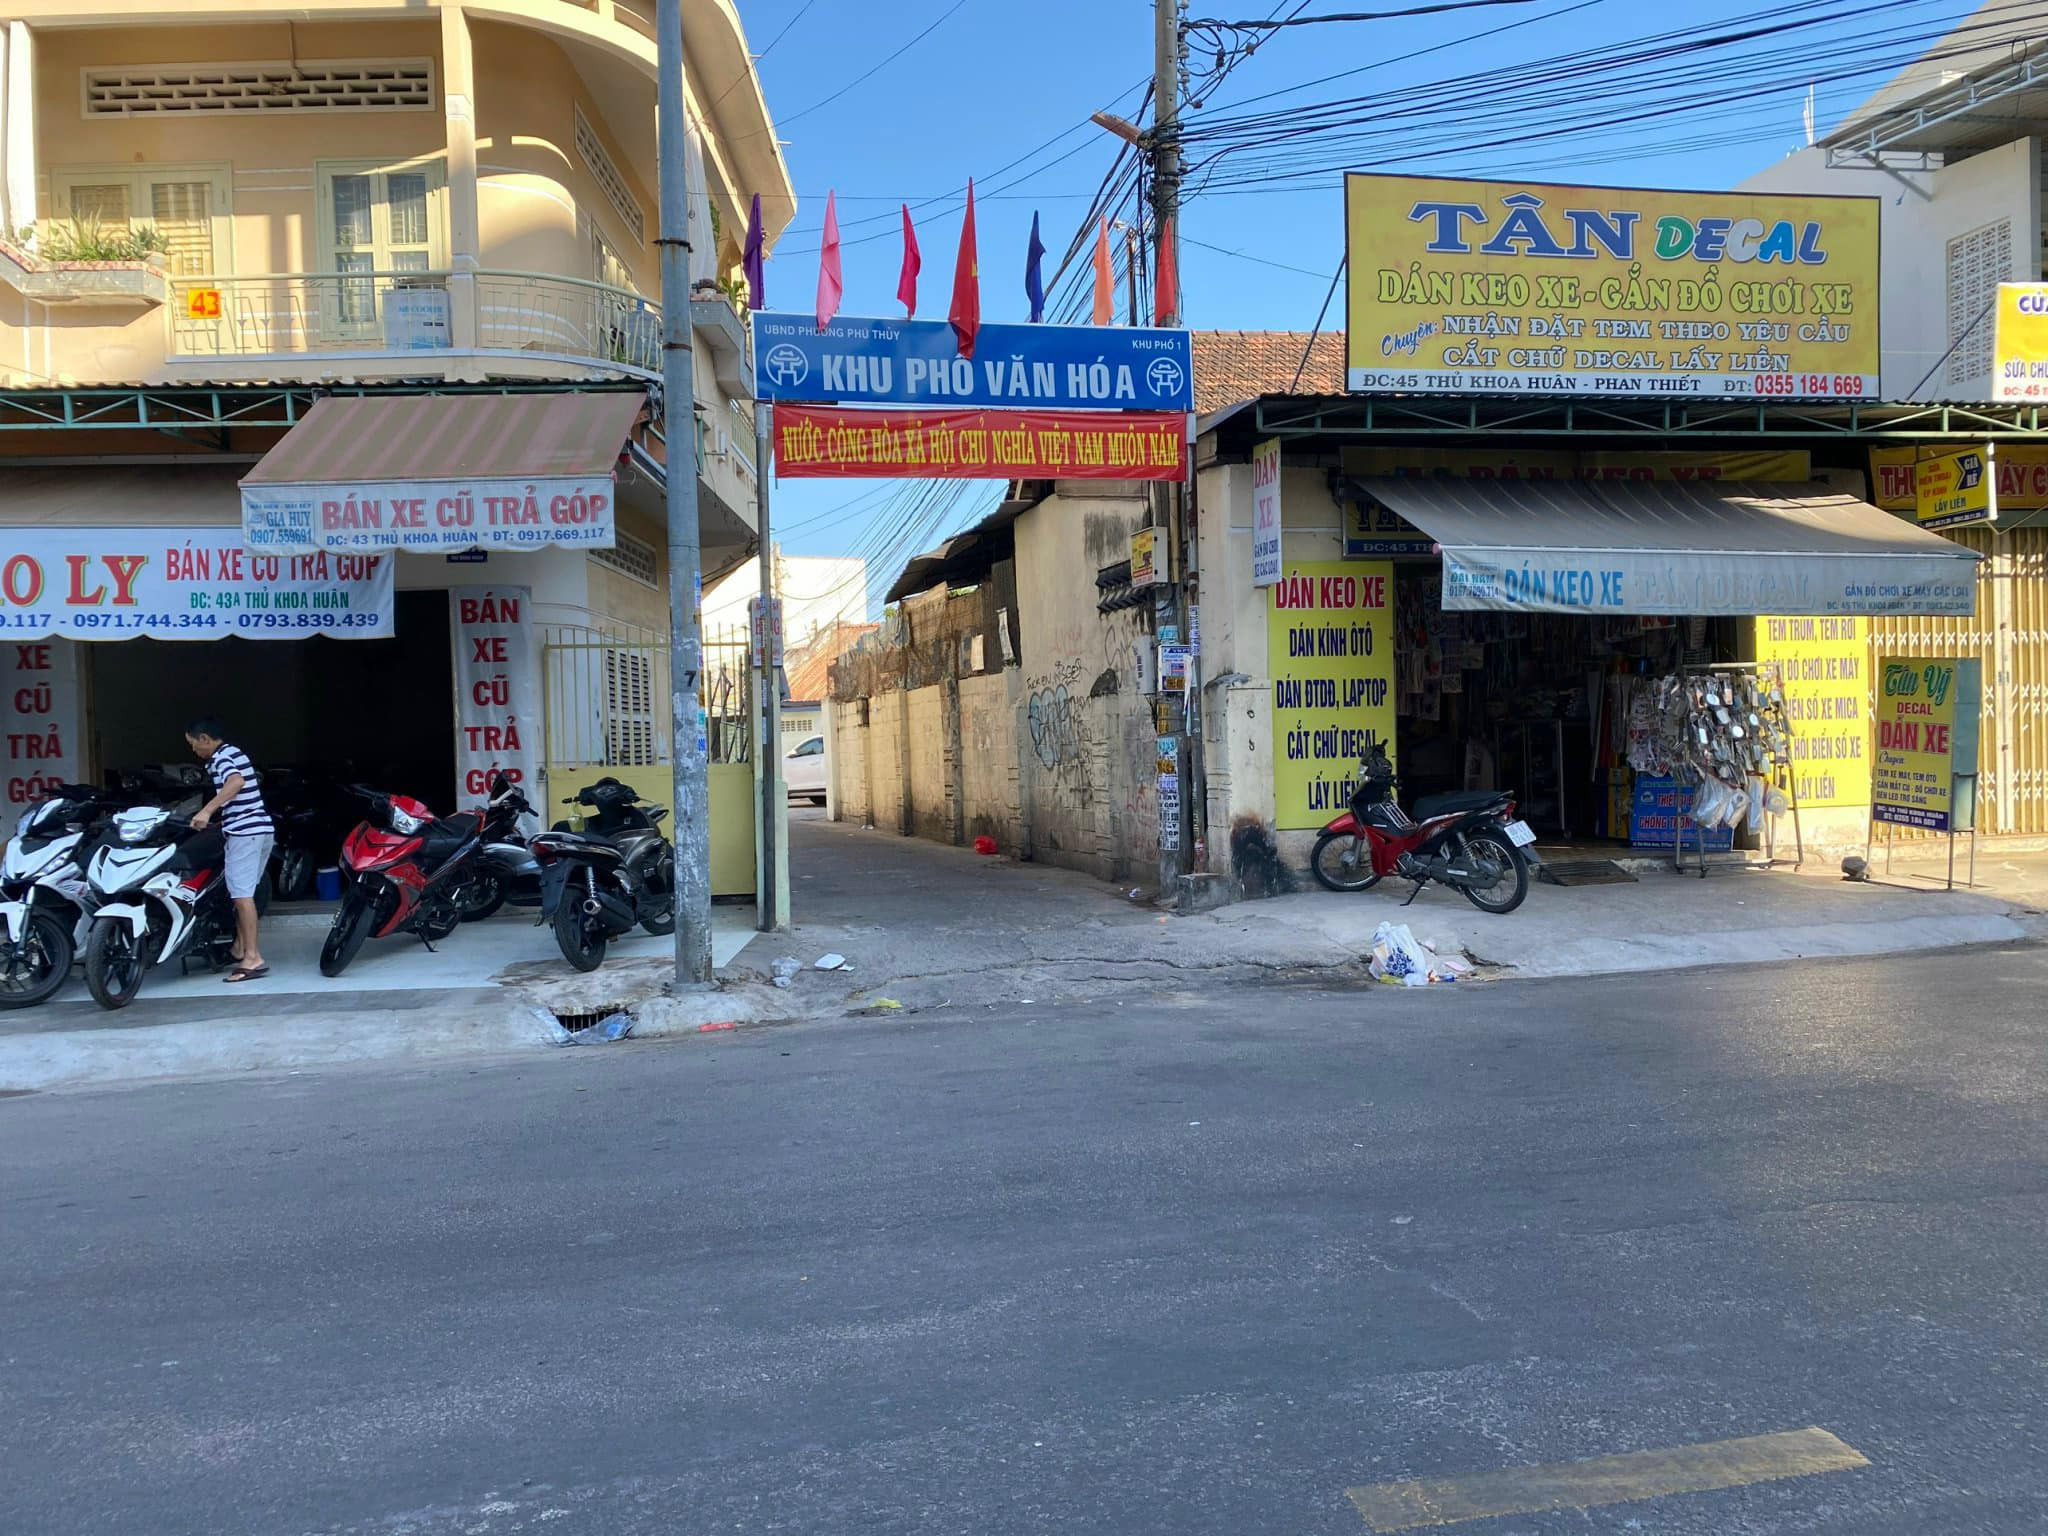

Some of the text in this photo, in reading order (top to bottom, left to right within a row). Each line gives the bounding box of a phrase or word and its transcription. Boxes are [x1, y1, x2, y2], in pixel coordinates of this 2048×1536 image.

[1407, 191, 1827, 264] TÂN DECAL
[191, 292, 220, 316] 43
[1377, 261, 1454, 305] DÁN
[1461, 273, 1530, 307] KEO
[1677, 264, 1722, 313] ĐỒ
[1730, 277, 1805, 314] CHƠI
[1810, 283, 1853, 315] XE
[764, 324, 795, 336] UBND
[873, 326, 900, 341] THỦY
[1442, 311, 1850, 342] NHẬN ĐẶT TEM THEO YÊU CẦU
[1132, 340, 1151, 350] KHU
[1155, 338, 1173, 350] PHỐ
[1442, 339, 1790, 372] CẮT CHỮ DECAL LẤY LIỀN
[822, 354, 892, 394] KHU
[983, 354, 1056, 398] VĂN
[1067, 356, 1136, 399] HÓA
[1425, 371, 1462, 389] THỦ
[1470, 377, 1522, 389] KHOA
[1527, 374, 1577, 390] HUÂN
[1595, 377, 1641, 391] PHAN
[1647, 374, 1701, 392] THIẾT
[1754, 374, 1794, 395] 0355
[1800, 375, 1828, 394] 184
[1833, 375, 1862, 395] 669
[2025, 385, 2040, 396] 45
[782, 416, 1179, 472] NƯỚC CỘNG HÒA XÃ HỘI CHỦ NGHĨA VIỆT NAM MUÔN NĂM
[1254, 446, 1277, 489] DÁN
[266, 511, 311, 527] GIA HUY
[322, 485, 608, 530] BÁN XE CŨ TRẢ GÓP
[1258, 496, 1273, 531] XE
[352, 535, 369, 545] 43
[372, 532, 399, 545] THỦ
[403, 533, 438, 544] KHOA
[443, 530, 478, 543] HUÂN
[518, 528, 605, 540] 0917.669.117
[166, 540, 243, 581] BÁN XE
[64, 555, 149, 607] LY
[191, 585, 349, 609] ĐC: 43A THỦ KHOA HUÂN
[1275, 571, 1384, 609] DÁN KEO XE
[1505, 559, 1624, 606] DÁN KEO XE
[74, 613, 217, 628] 0971.744.344
[239, 613, 379, 628] 0793.839.439
[460, 592, 520, 624] BÁN
[1289, 620, 1373, 657] DÁN KÍNH ÔTÔ
[1768, 619, 1786, 641] TEM
[1820, 618, 1838, 641] TEM
[16, 645, 51, 670] XE
[472, 637, 509, 663] XE
[1787, 650, 1860, 681] ĐỒ CHƠI XE MÁY
[472, 675, 510, 706] CŨ
[684, 670, 697, 687] 7
[1276, 673, 1301, 709] DÁN
[1343, 678, 1387, 707] LAPTOP
[14, 682, 52, 714] CŨ
[1807, 688, 1858, 720] SỐ XE MICA
[1897, 702, 1933, 716] DECAL
[7, 723, 63, 759] TRẢ
[464, 715, 521, 752] TRẢ
[1287, 719, 1310, 760] CẮT
[1314, 724, 1339, 760] CHỮ
[1811, 728, 1833, 760] BIỂN
[1835, 728, 1848, 759] SỐ
[1850, 735, 1861, 758] XE
[1923, 723, 1949, 754] XE
[1308, 770, 1330, 810] LẤY
[1796, 769, 1835, 800] LẤY LIỀN
